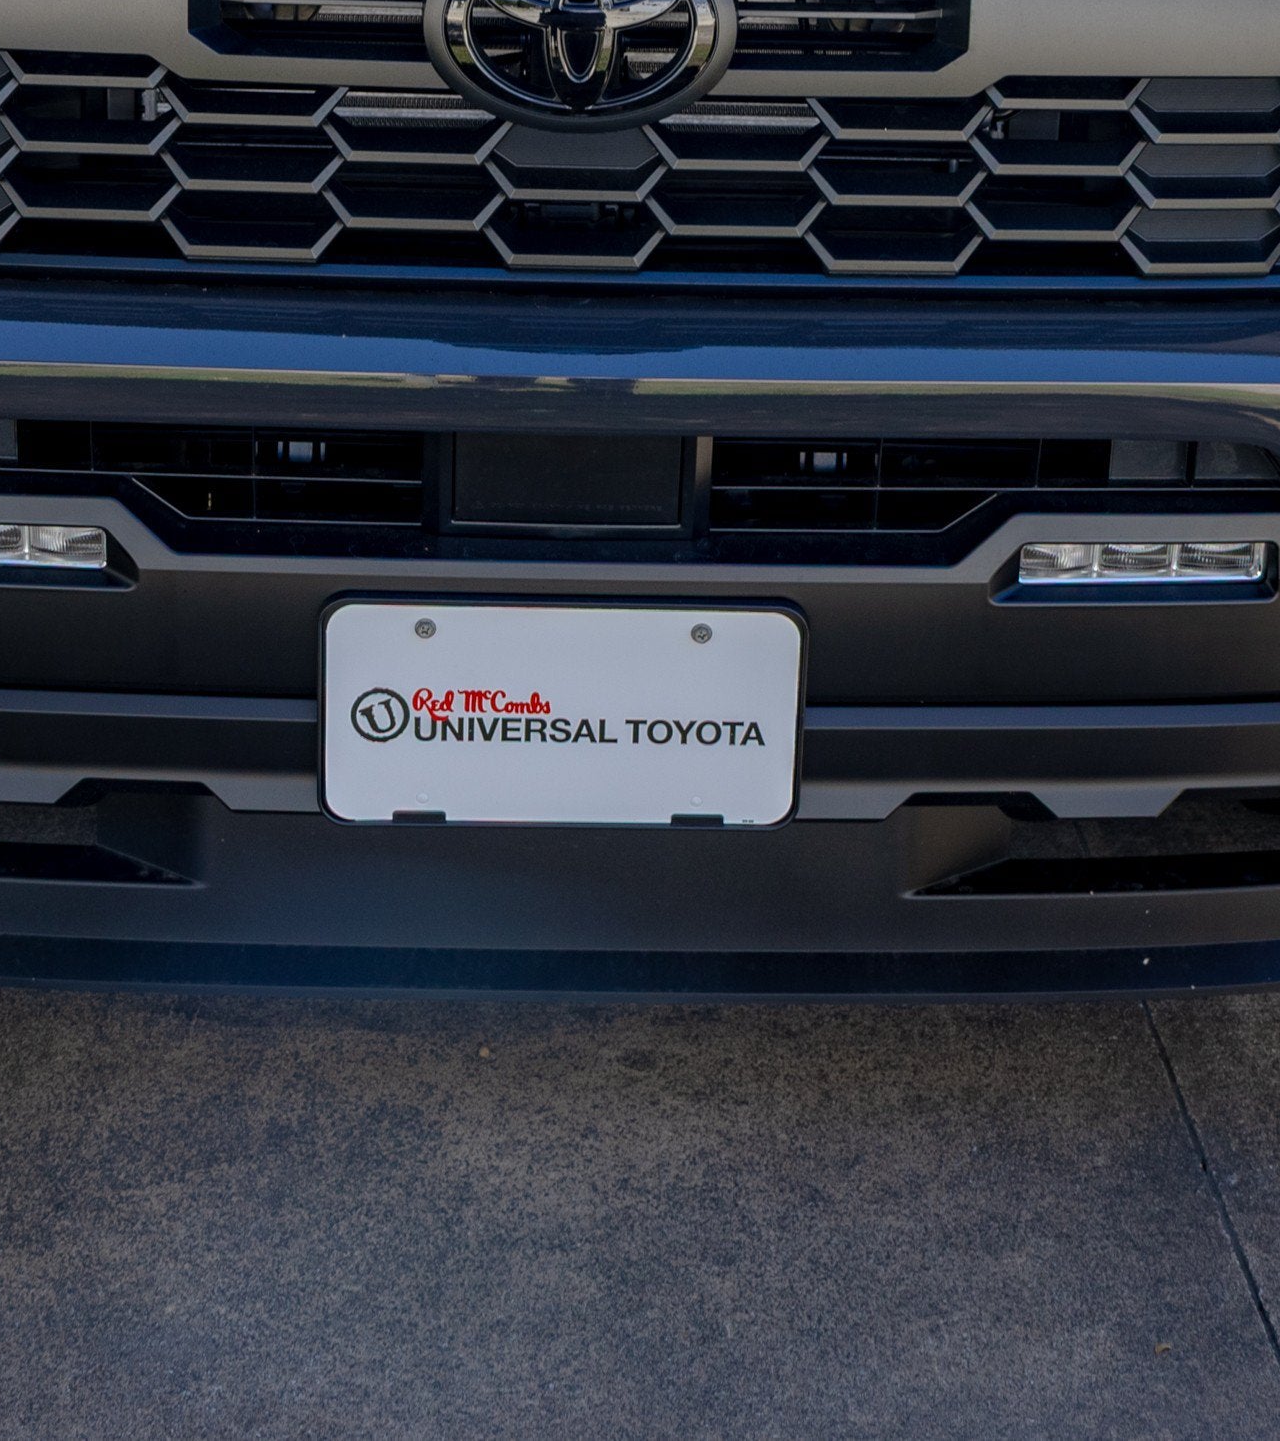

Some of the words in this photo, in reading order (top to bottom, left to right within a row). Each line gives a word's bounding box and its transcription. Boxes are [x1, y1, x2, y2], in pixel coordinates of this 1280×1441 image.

[412, 687, 455, 721] Red
[458, 688, 551, 715] McCombs
[414, 716, 618, 744] UNIVERSAL
[625, 719, 766, 746] TOYOTA
